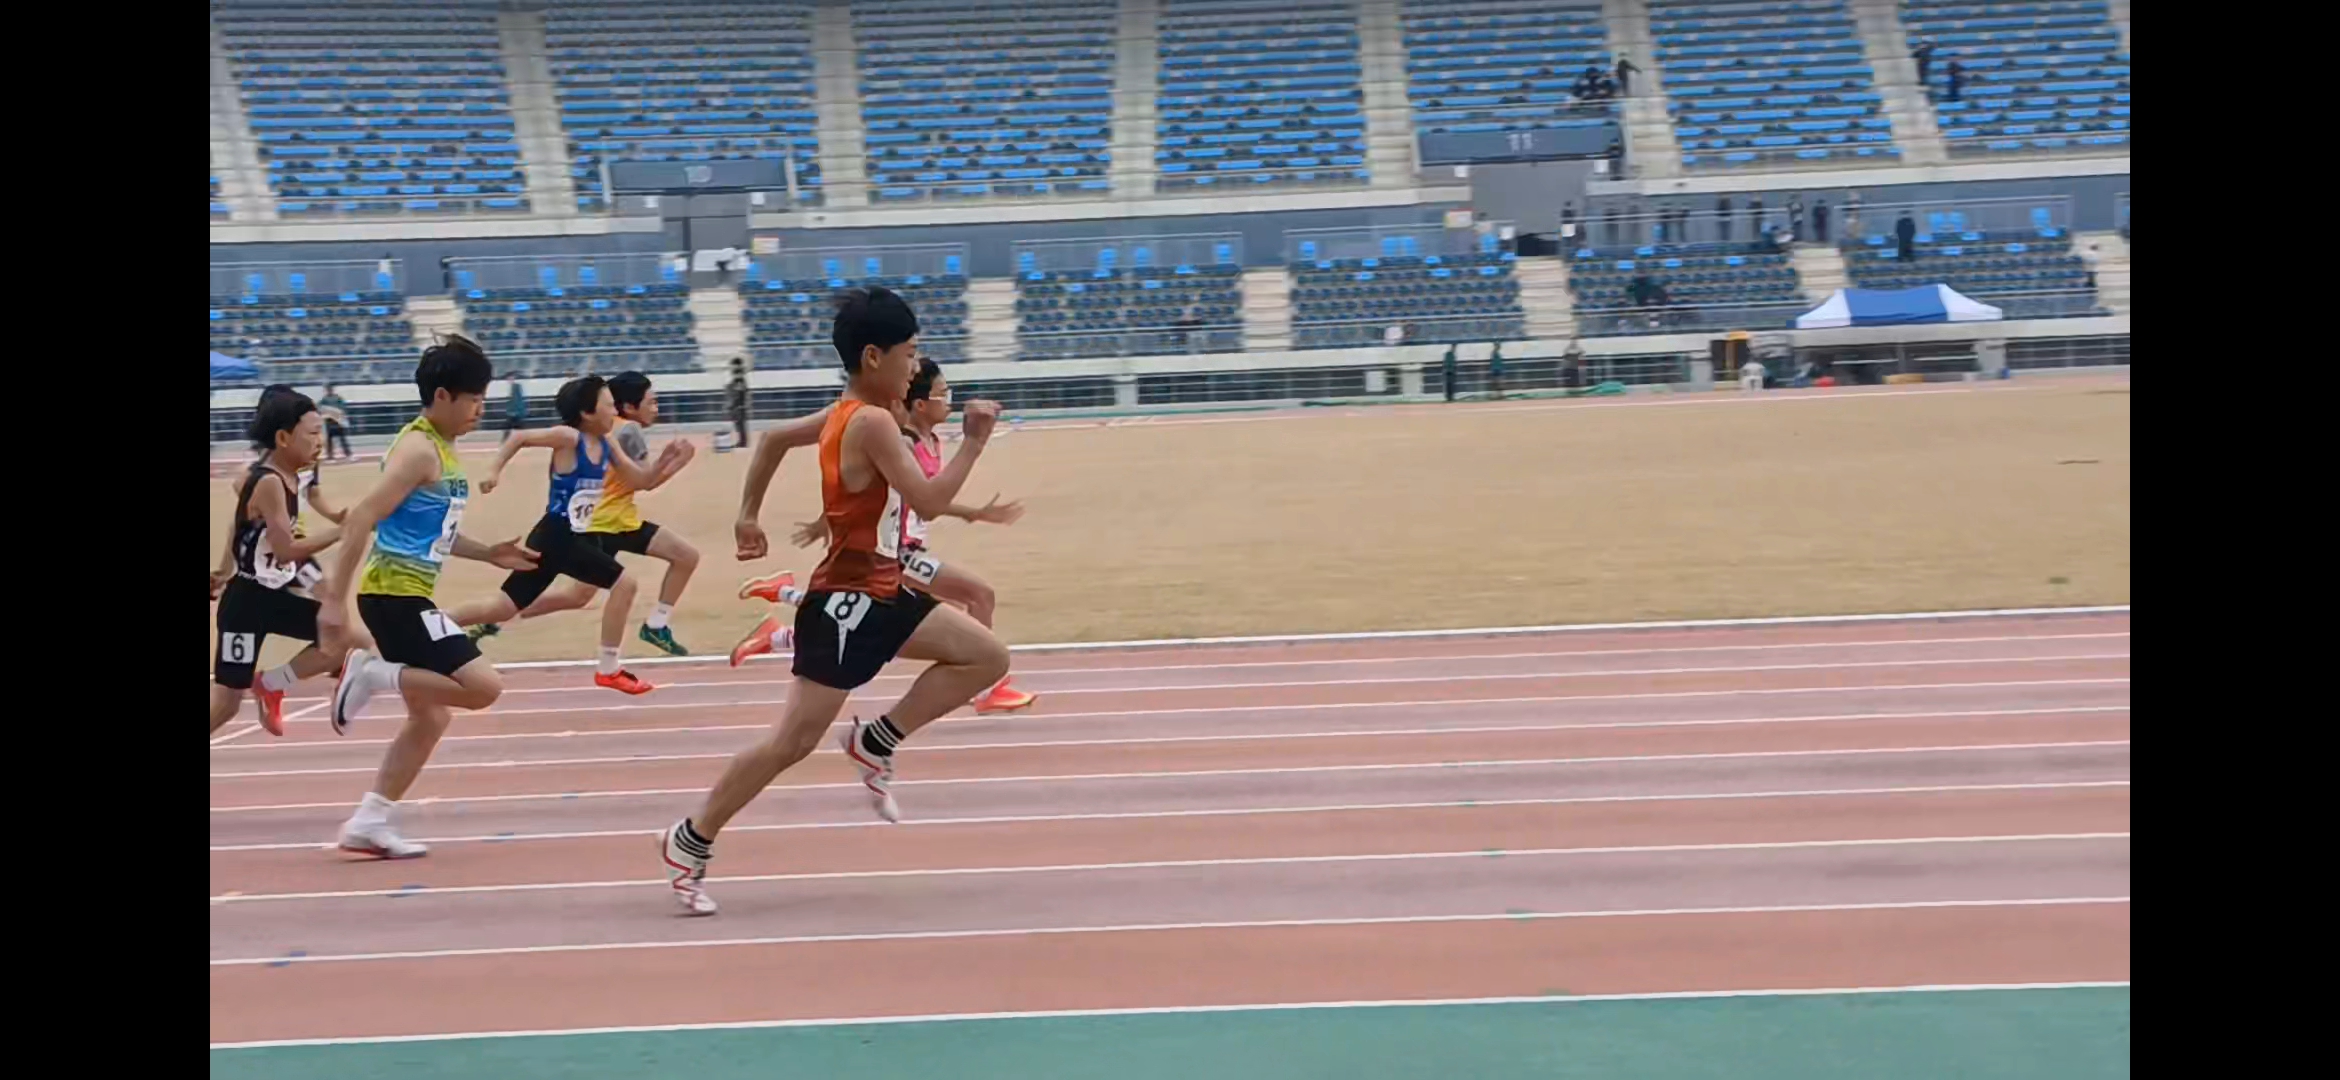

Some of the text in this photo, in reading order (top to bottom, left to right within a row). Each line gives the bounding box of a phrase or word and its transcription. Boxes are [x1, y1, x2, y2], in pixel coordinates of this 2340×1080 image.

[909, 557, 935, 578] 5
[834, 592, 861, 620] 8
[429, 610, 448, 635] 7
[231, 634, 246, 661] 6
